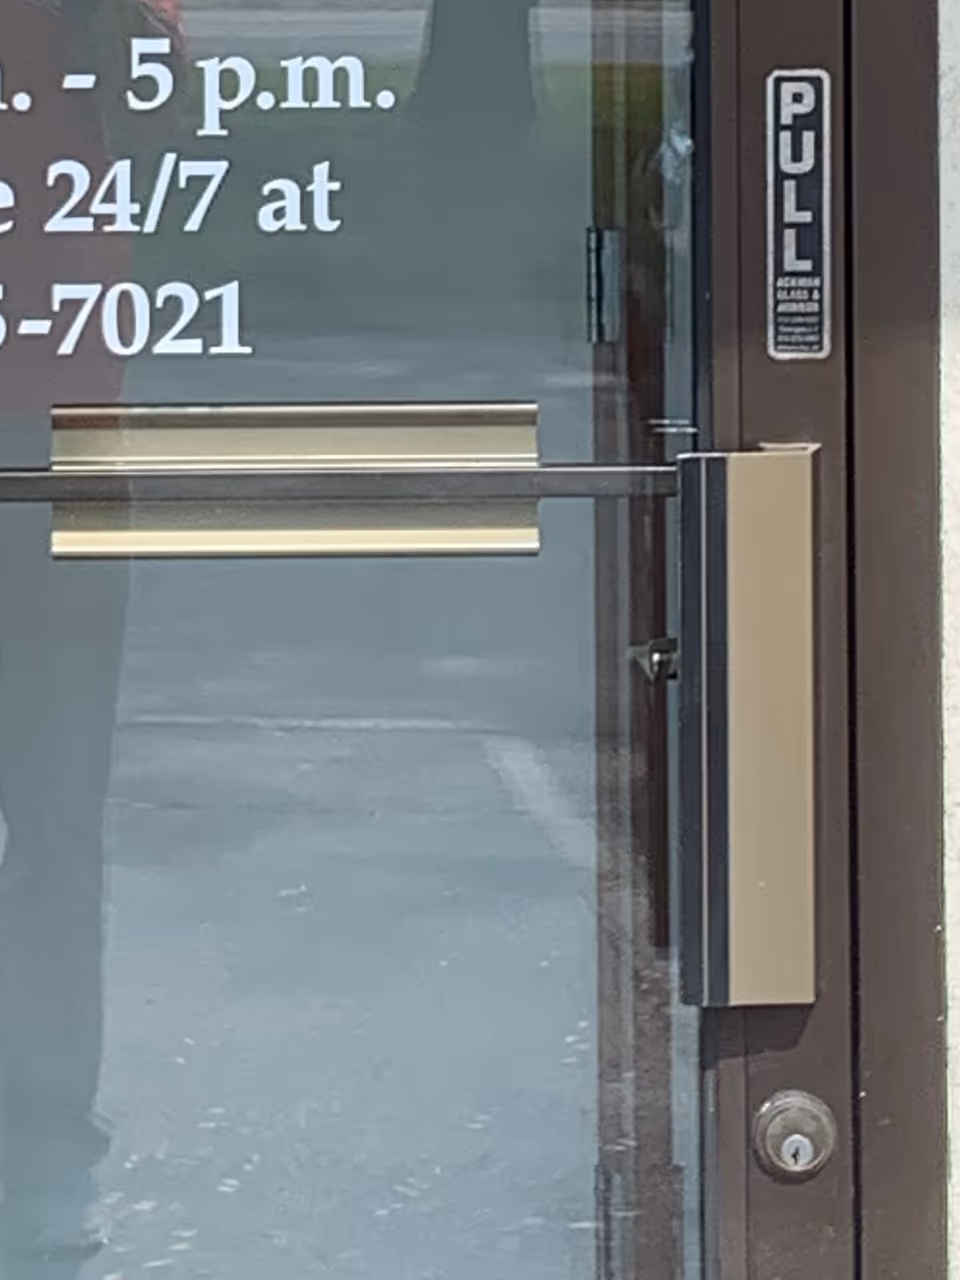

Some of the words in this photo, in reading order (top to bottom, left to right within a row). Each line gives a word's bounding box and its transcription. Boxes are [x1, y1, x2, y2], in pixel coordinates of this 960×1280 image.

[62, 74, 96, 89] -
[126, 37, 173, 111] 5
[195, 55, 395, 136] p.m.
[43, 153, 229, 233] 24/7
[258, 160, 341, 232] at
[778, 81, 816, 271] PULL
